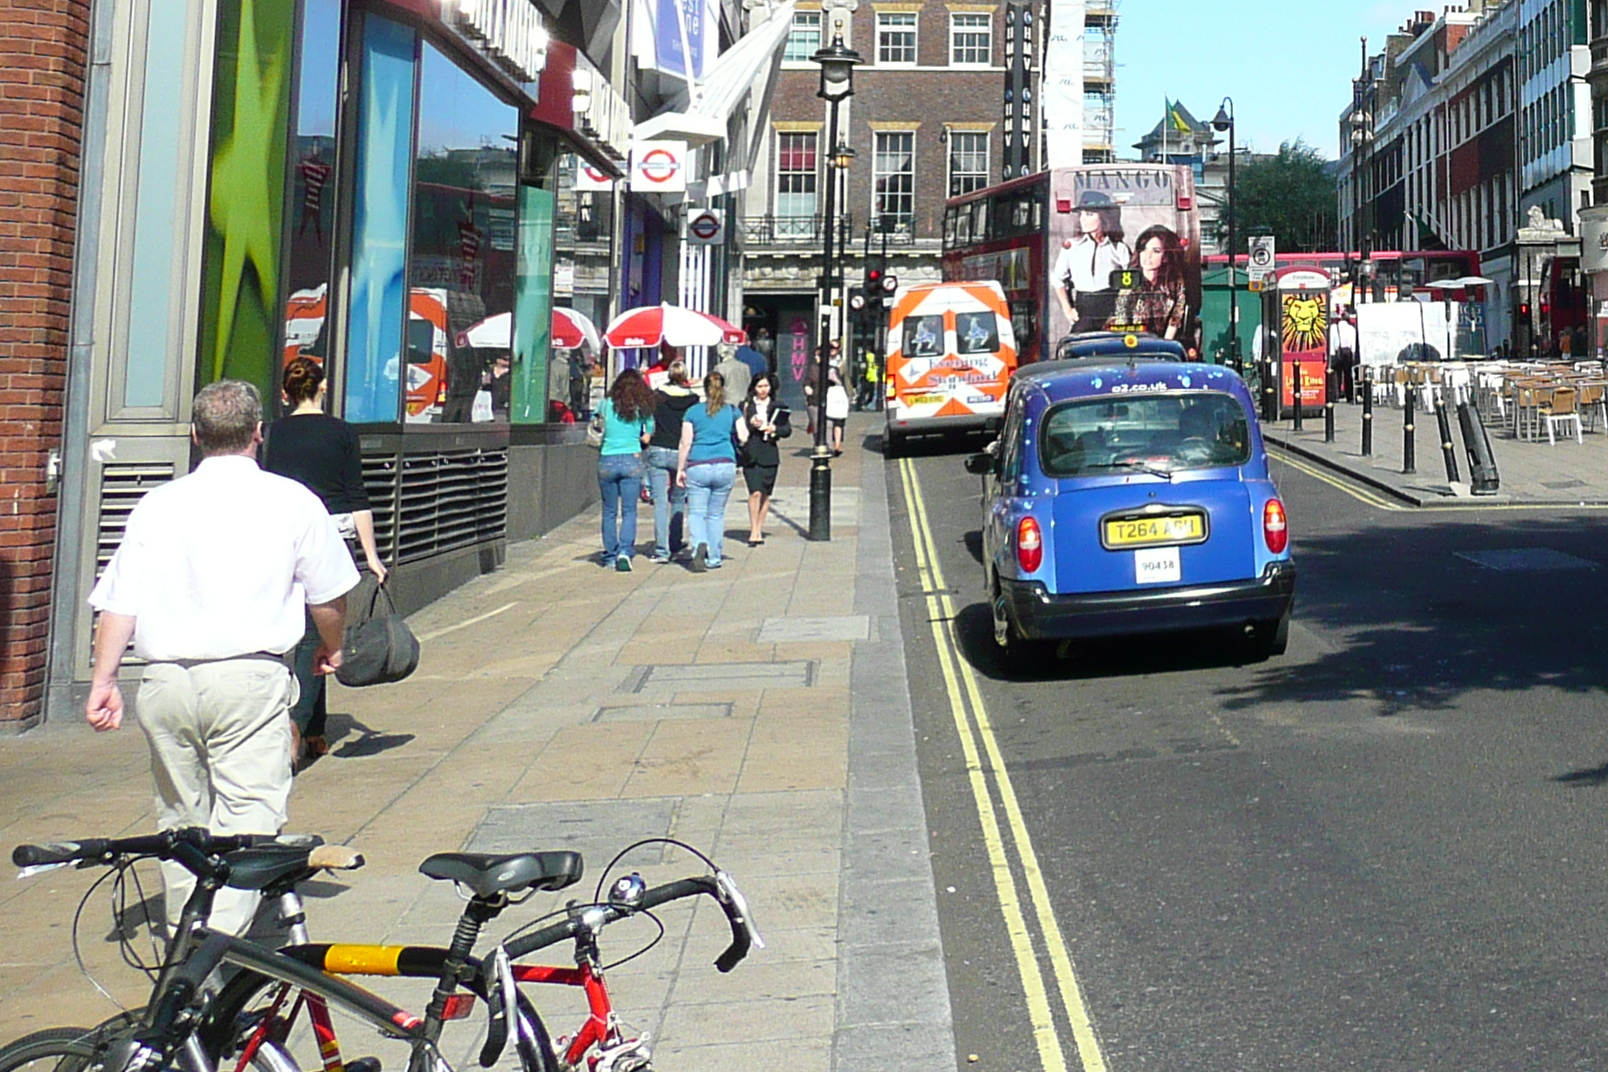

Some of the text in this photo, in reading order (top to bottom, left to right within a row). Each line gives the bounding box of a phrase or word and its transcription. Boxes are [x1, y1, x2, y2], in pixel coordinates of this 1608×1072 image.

[1023, 26, 1032, 70] HMV
[1022, 103, 1031, 147] HMV
[1075, 170, 1169, 189] MANGO
[791, 338, 807, 381] HMV
[929, 357, 988, 369] Evening
[928, 370, 998, 385] Standard
[1116, 521, 1158, 539] T264
